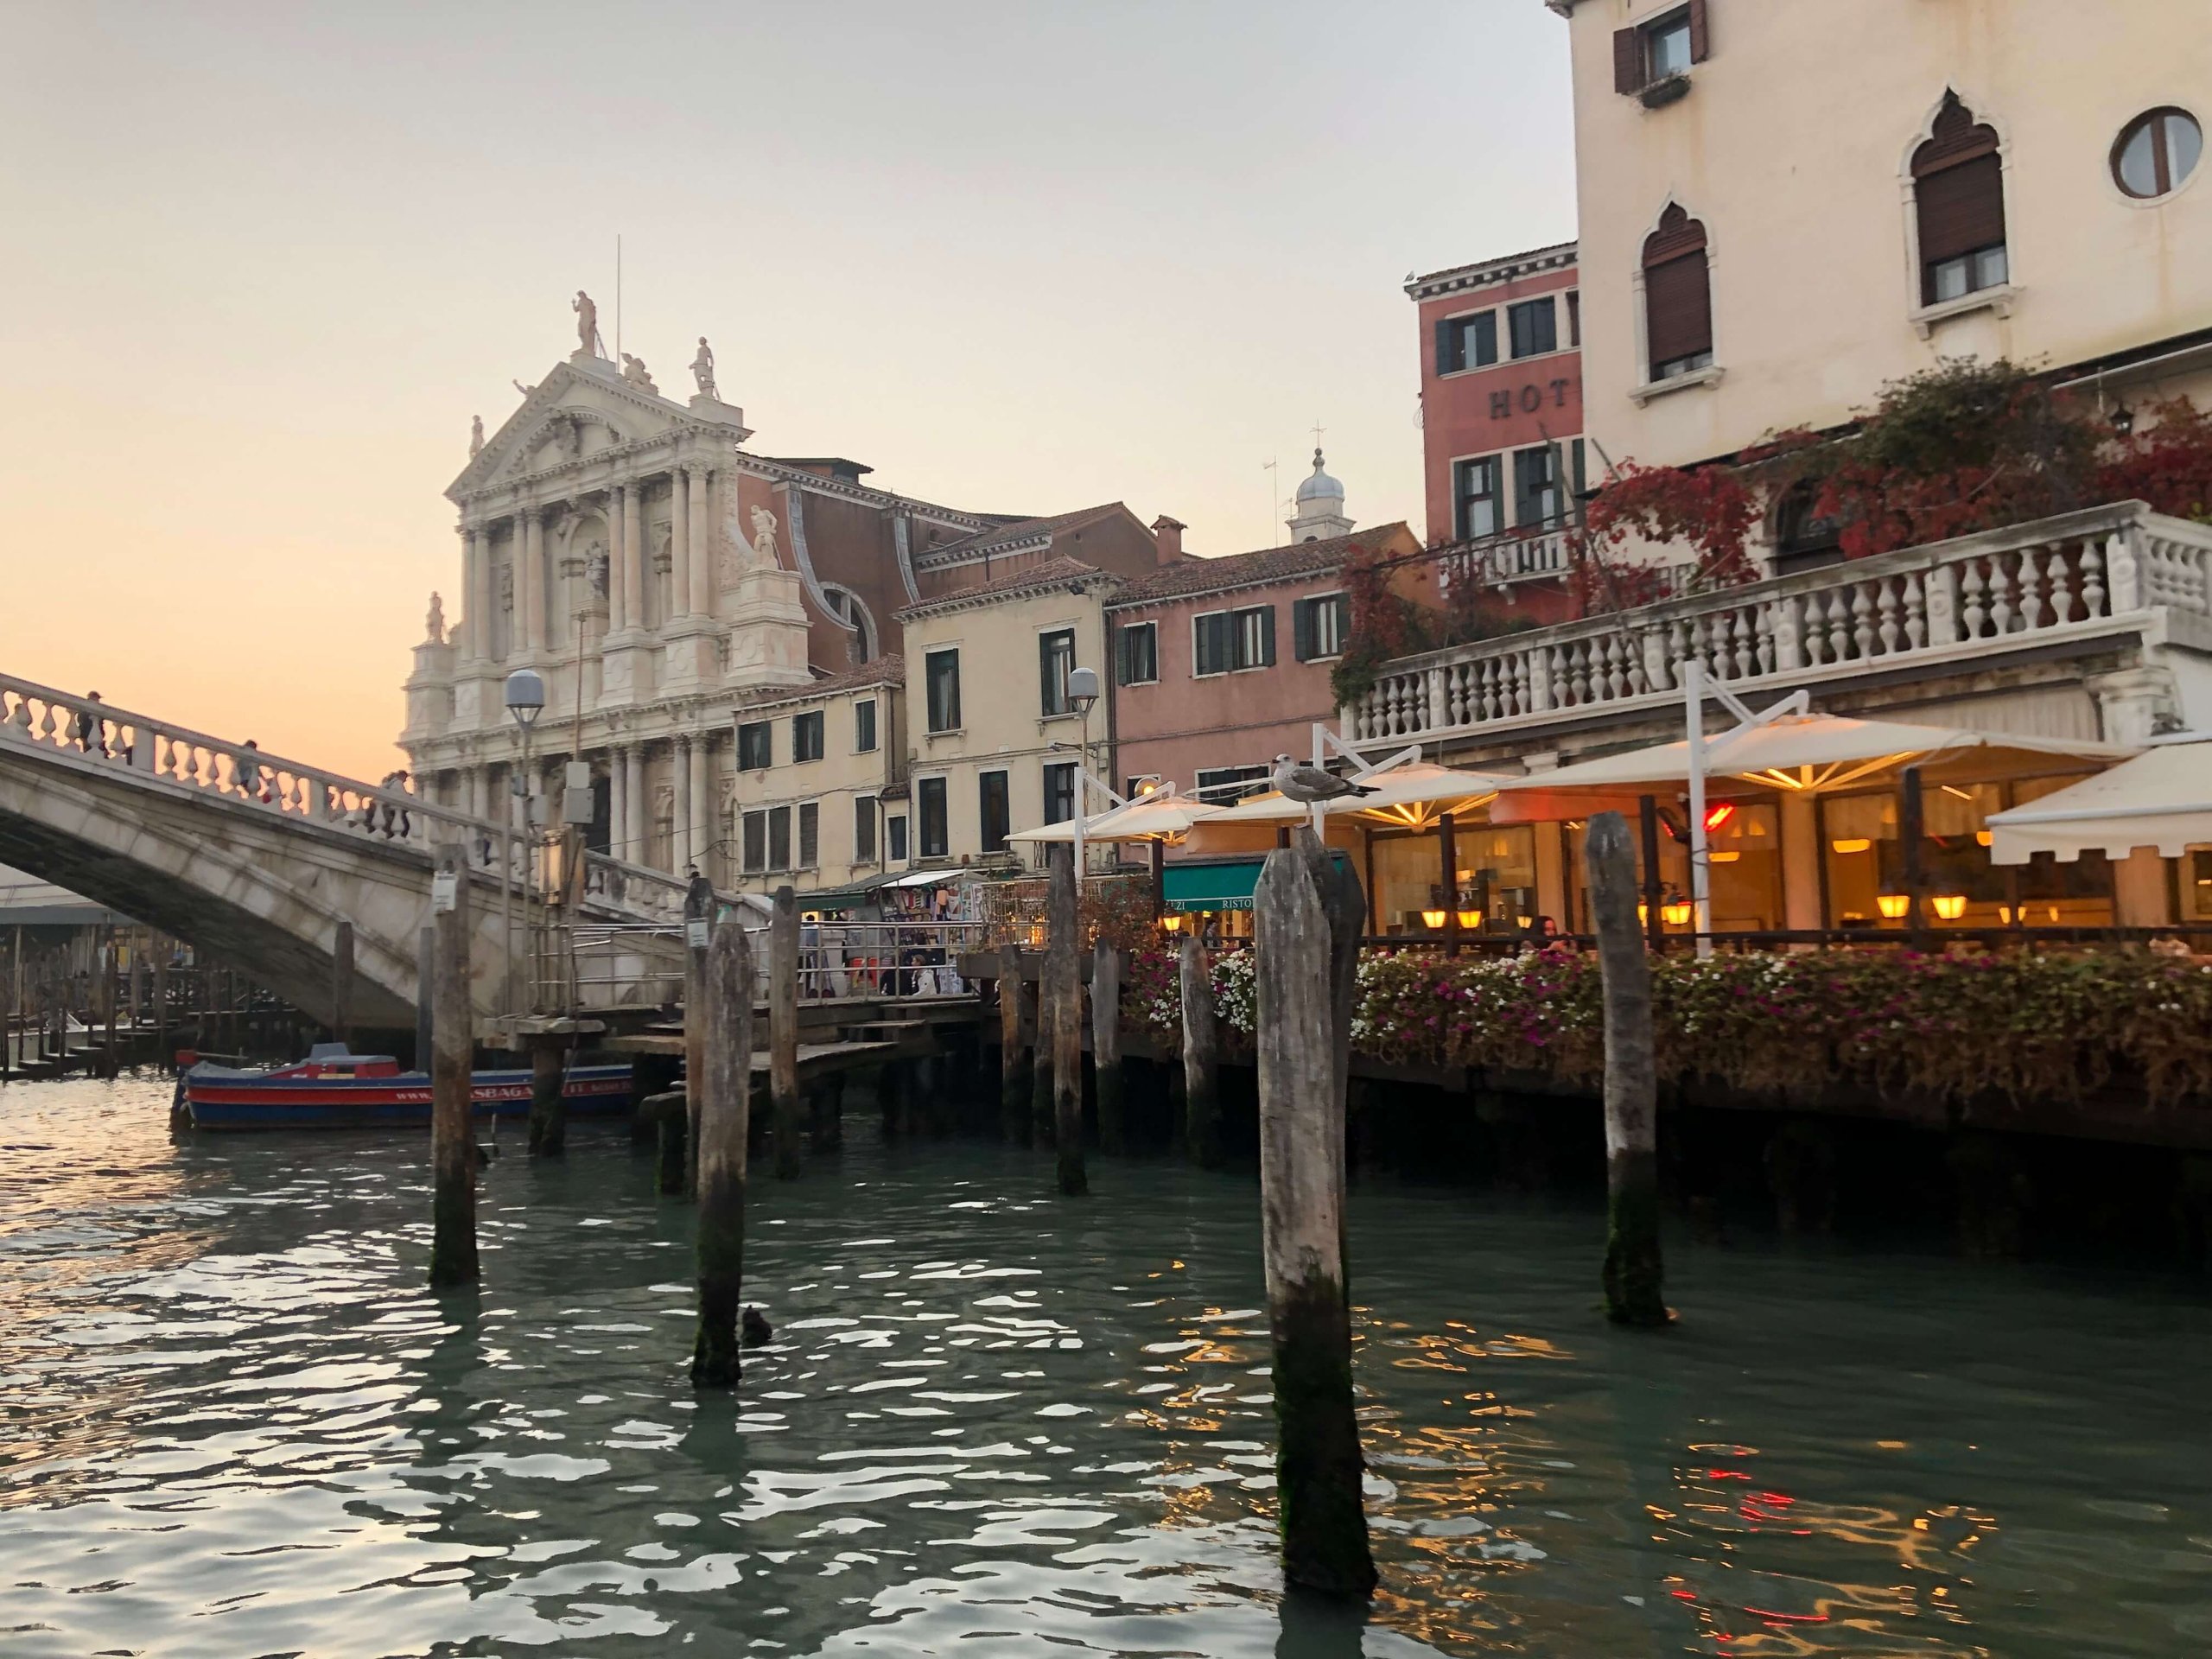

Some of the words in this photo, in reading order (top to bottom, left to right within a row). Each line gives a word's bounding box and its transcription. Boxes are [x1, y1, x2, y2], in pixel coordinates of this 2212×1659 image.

[1489, 377, 1570, 420] HOT
[1222, 899, 1252, 909] RISTO
[470, 1086, 535, 1099] SBAGA
